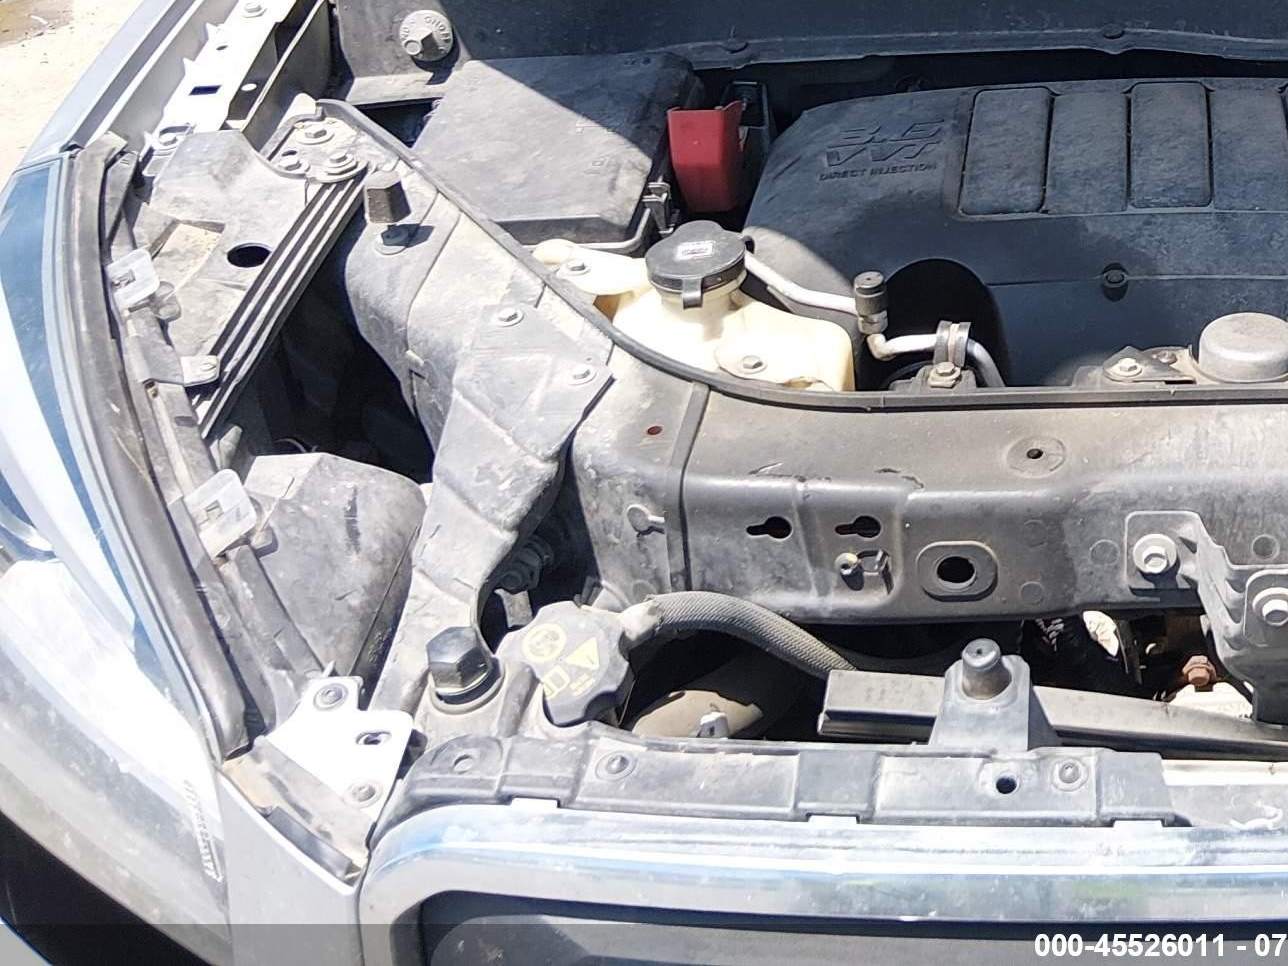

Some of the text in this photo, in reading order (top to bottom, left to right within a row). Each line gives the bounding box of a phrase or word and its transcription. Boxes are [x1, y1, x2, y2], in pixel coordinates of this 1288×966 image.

[828, 119, 945, 148] 3.6
[825, 140, 942, 166] VVT
[819, 162, 938, 181] DIRECT INJECTION
